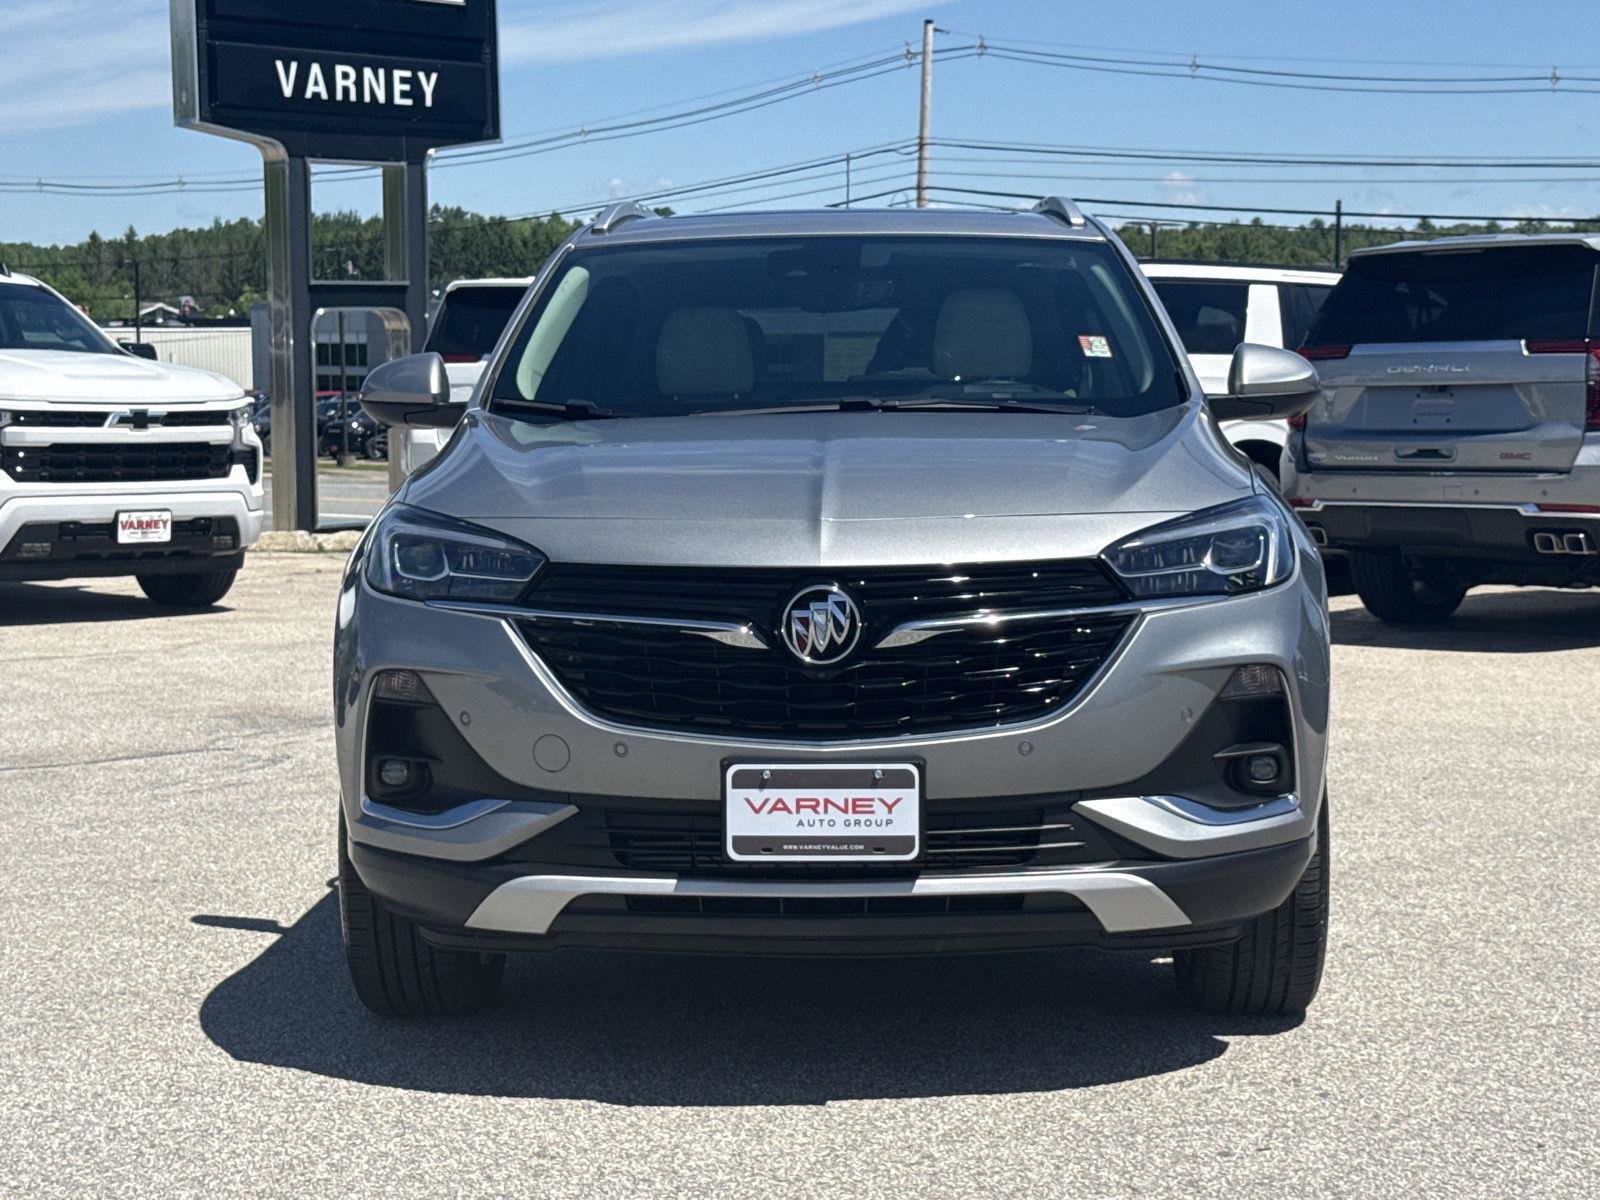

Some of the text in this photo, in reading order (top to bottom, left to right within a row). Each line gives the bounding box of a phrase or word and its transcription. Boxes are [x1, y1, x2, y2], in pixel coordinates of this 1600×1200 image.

[274, 60, 439, 107] VARNEY
[1499, 452, 1532, 460] GMC
[120, 519, 169, 530] VARNEY
[743, 797, 904, 815] VARNEY
[796, 818, 894, 828] AUTO GROUP
